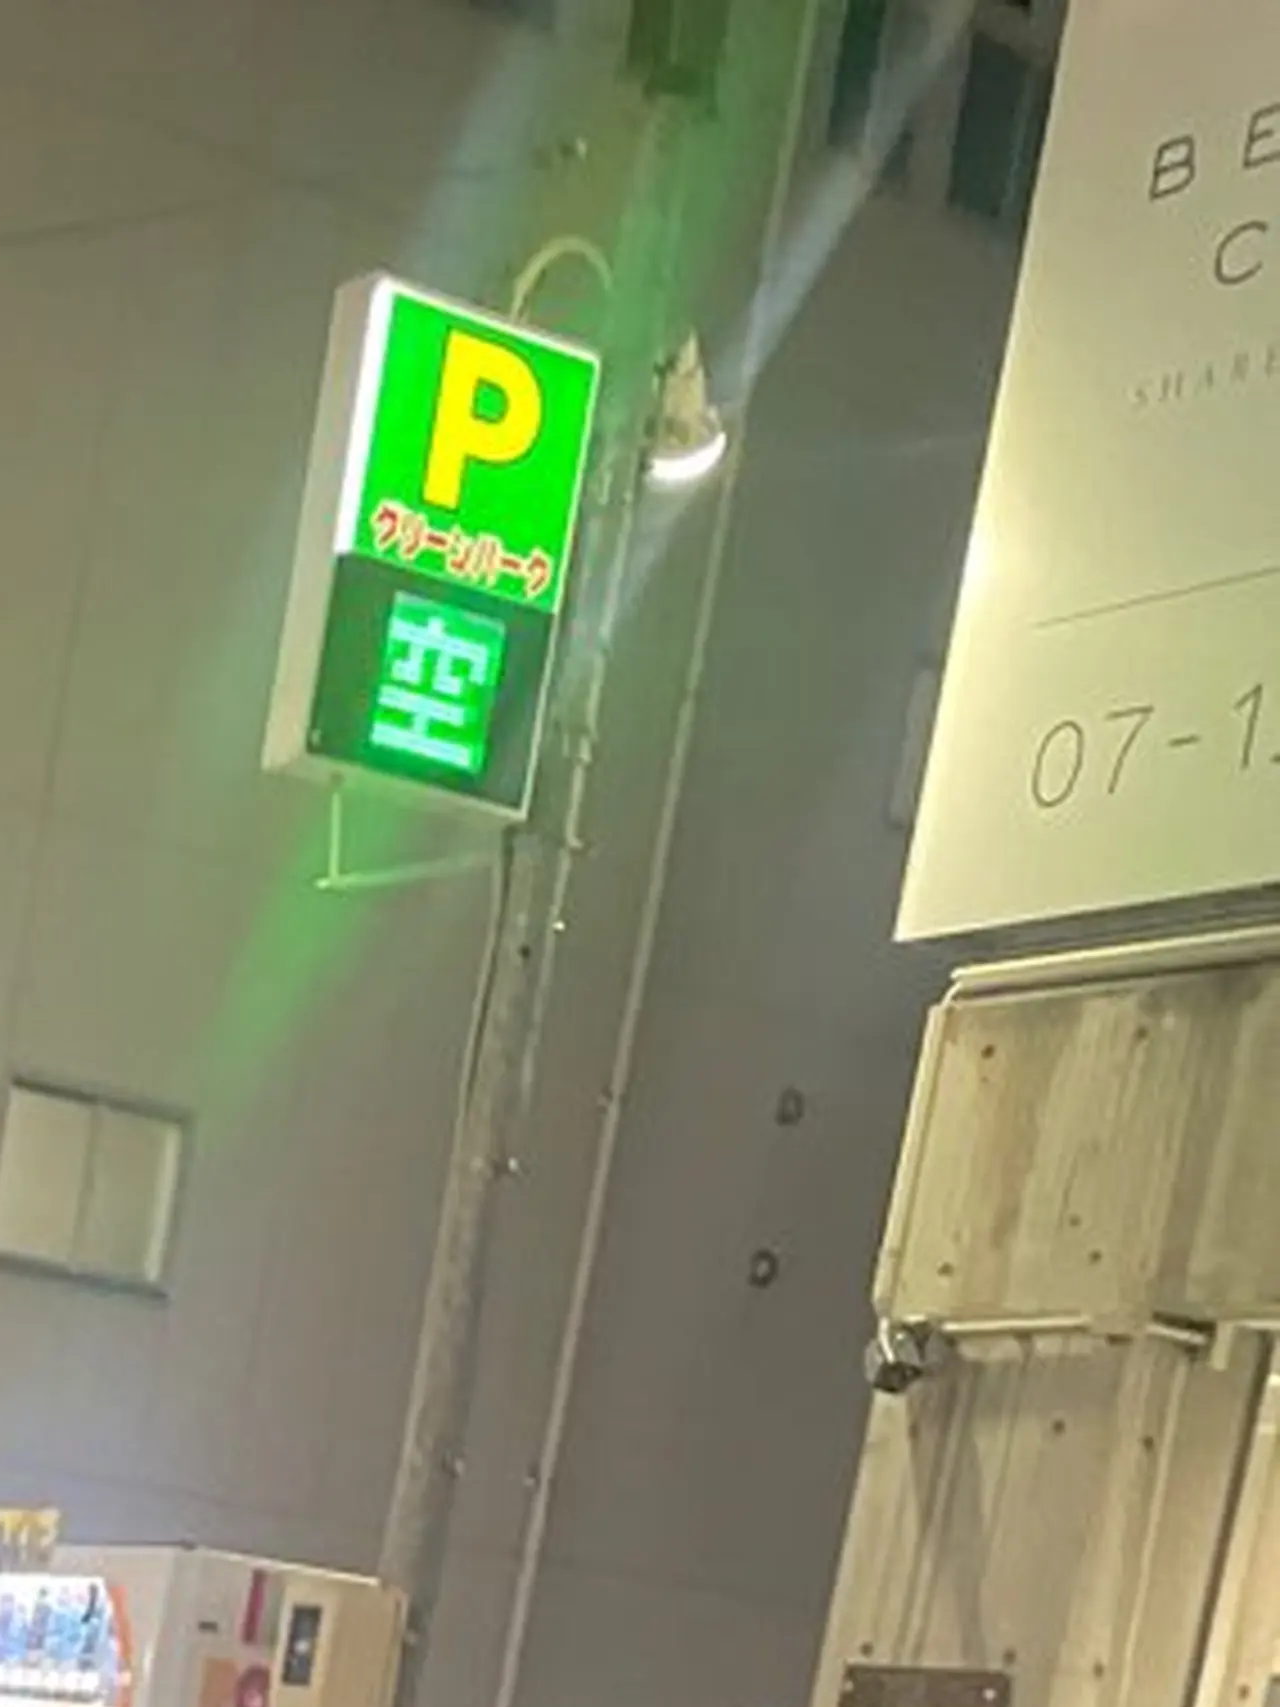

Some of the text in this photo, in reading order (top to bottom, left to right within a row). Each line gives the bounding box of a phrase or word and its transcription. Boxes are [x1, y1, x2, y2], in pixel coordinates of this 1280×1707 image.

[423, 328, 542, 511] P
[370, 616, 489, 767] 空
[1031, 683, 1280, 808] 07-1
